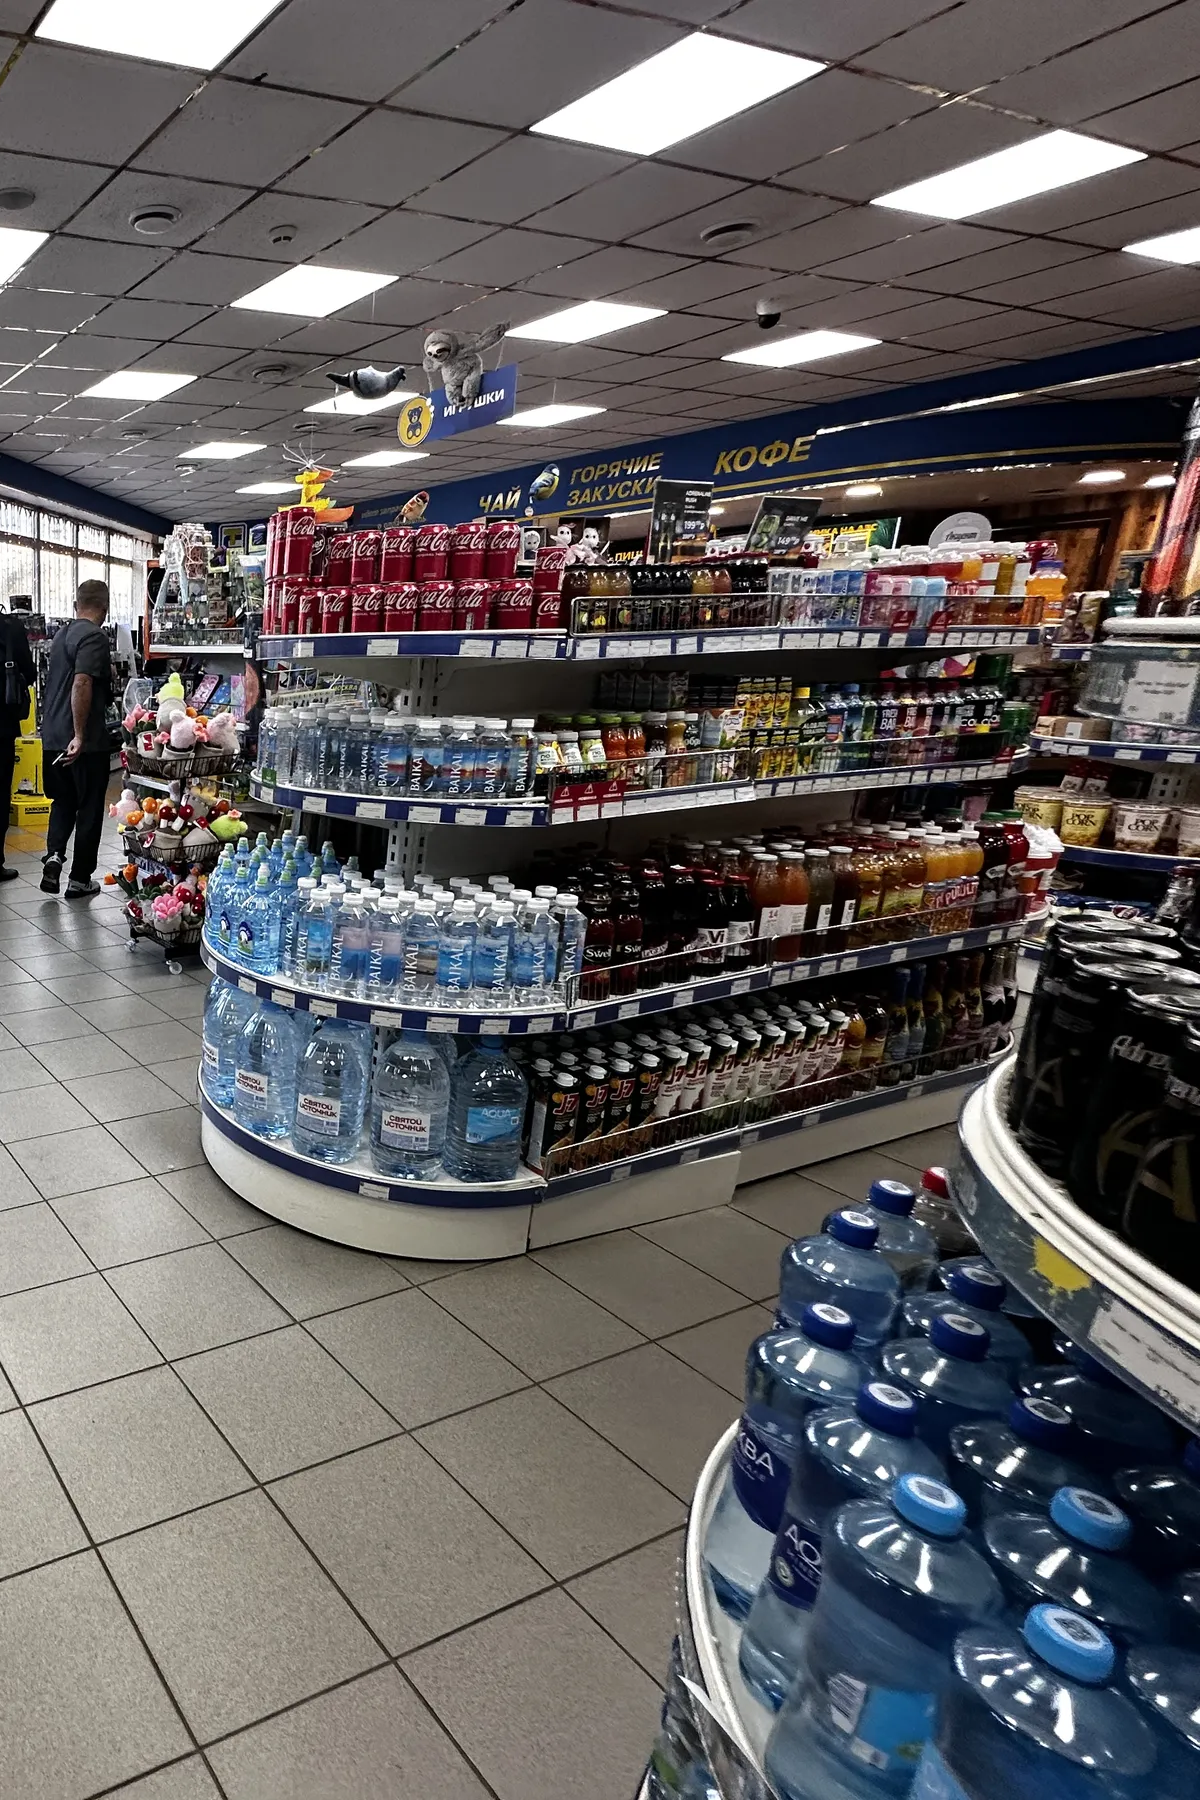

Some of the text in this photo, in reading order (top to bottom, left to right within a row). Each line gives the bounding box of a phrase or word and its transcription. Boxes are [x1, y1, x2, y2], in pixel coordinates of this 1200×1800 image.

[443, 388, 505, 418] ИГШКИ
[570, 451, 666, 485] ГОРЯЧИЕ
[712, 434, 817, 476] КОФЕ
[478, 485, 522, 514] ЧАЙ
[566, 475, 663, 507] ЗАКУСКИ
[377, 747, 390, 787] BAIKAL
[410, 750, 425, 791] BAIKAL
[448, 752, 464, 794] BAIKAL
[483, 751, 499, 793] BAIKAL
[515, 750, 530, 792] BAIKAL
[329, 934, 344, 981] BAIKAL
[368, 940, 384, 987] BAIKAL
[403, 943, 420, 992] BAIKAL
[447, 947, 465, 993] BAIKAL
[490, 945, 509, 994] BAIKAL
[531, 942, 546, 990] BAIKAL
[563, 937, 578, 981] AIKAL
[238, 1071, 261, 1086] СВЯТОЙ
[299, 1102, 338, 1119] ИСТОЧНИК
[303, 1097, 334, 1112] СВЯТОЙ
[388, 1114, 423, 1126] СВЯТОЙ
[481, 1107, 512, 1118] AQUA
[383, 1120, 427, 1133] ИСТОЧНИК
